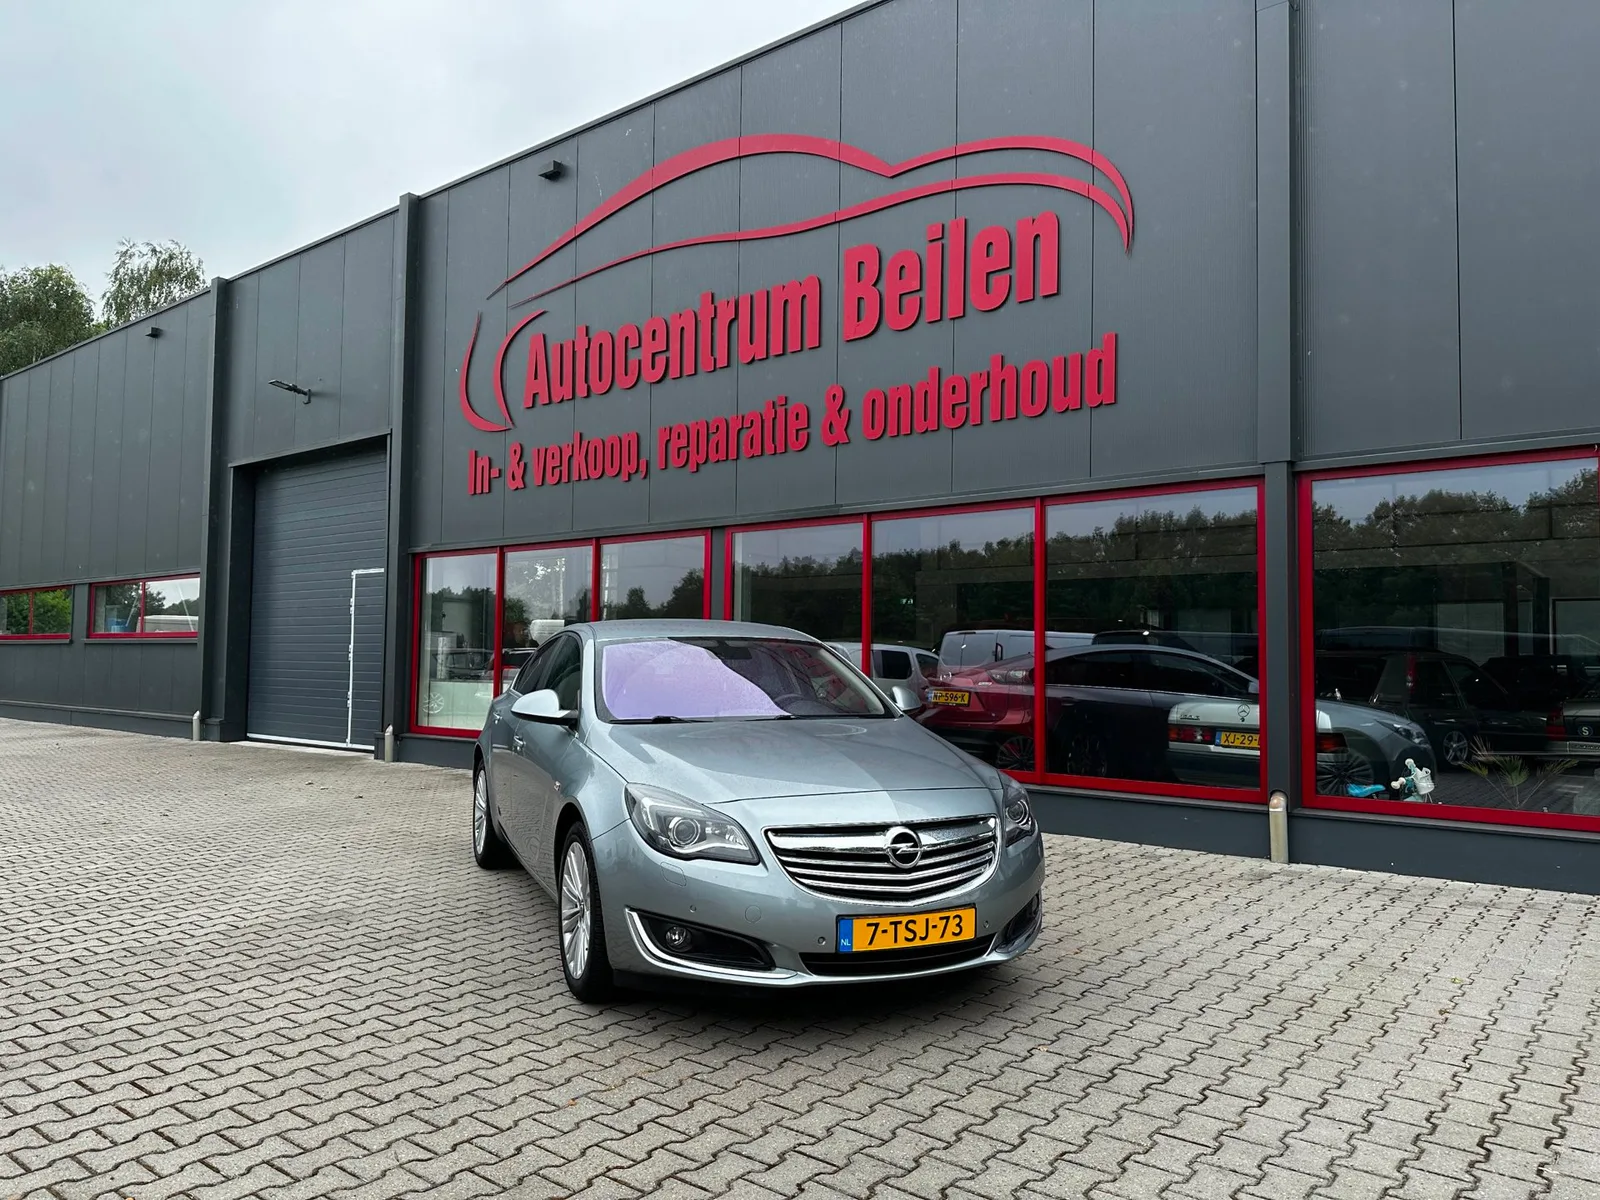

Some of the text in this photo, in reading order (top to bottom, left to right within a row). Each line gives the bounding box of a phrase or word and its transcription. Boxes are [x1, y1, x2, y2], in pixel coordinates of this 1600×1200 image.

[523, 211, 1060, 408] Autocentrum Beilen
[468, 332, 1117, 495] In- & verkoop, reparatie & onderhoud
[866, 914, 963, 945] 7-TSJ-73
